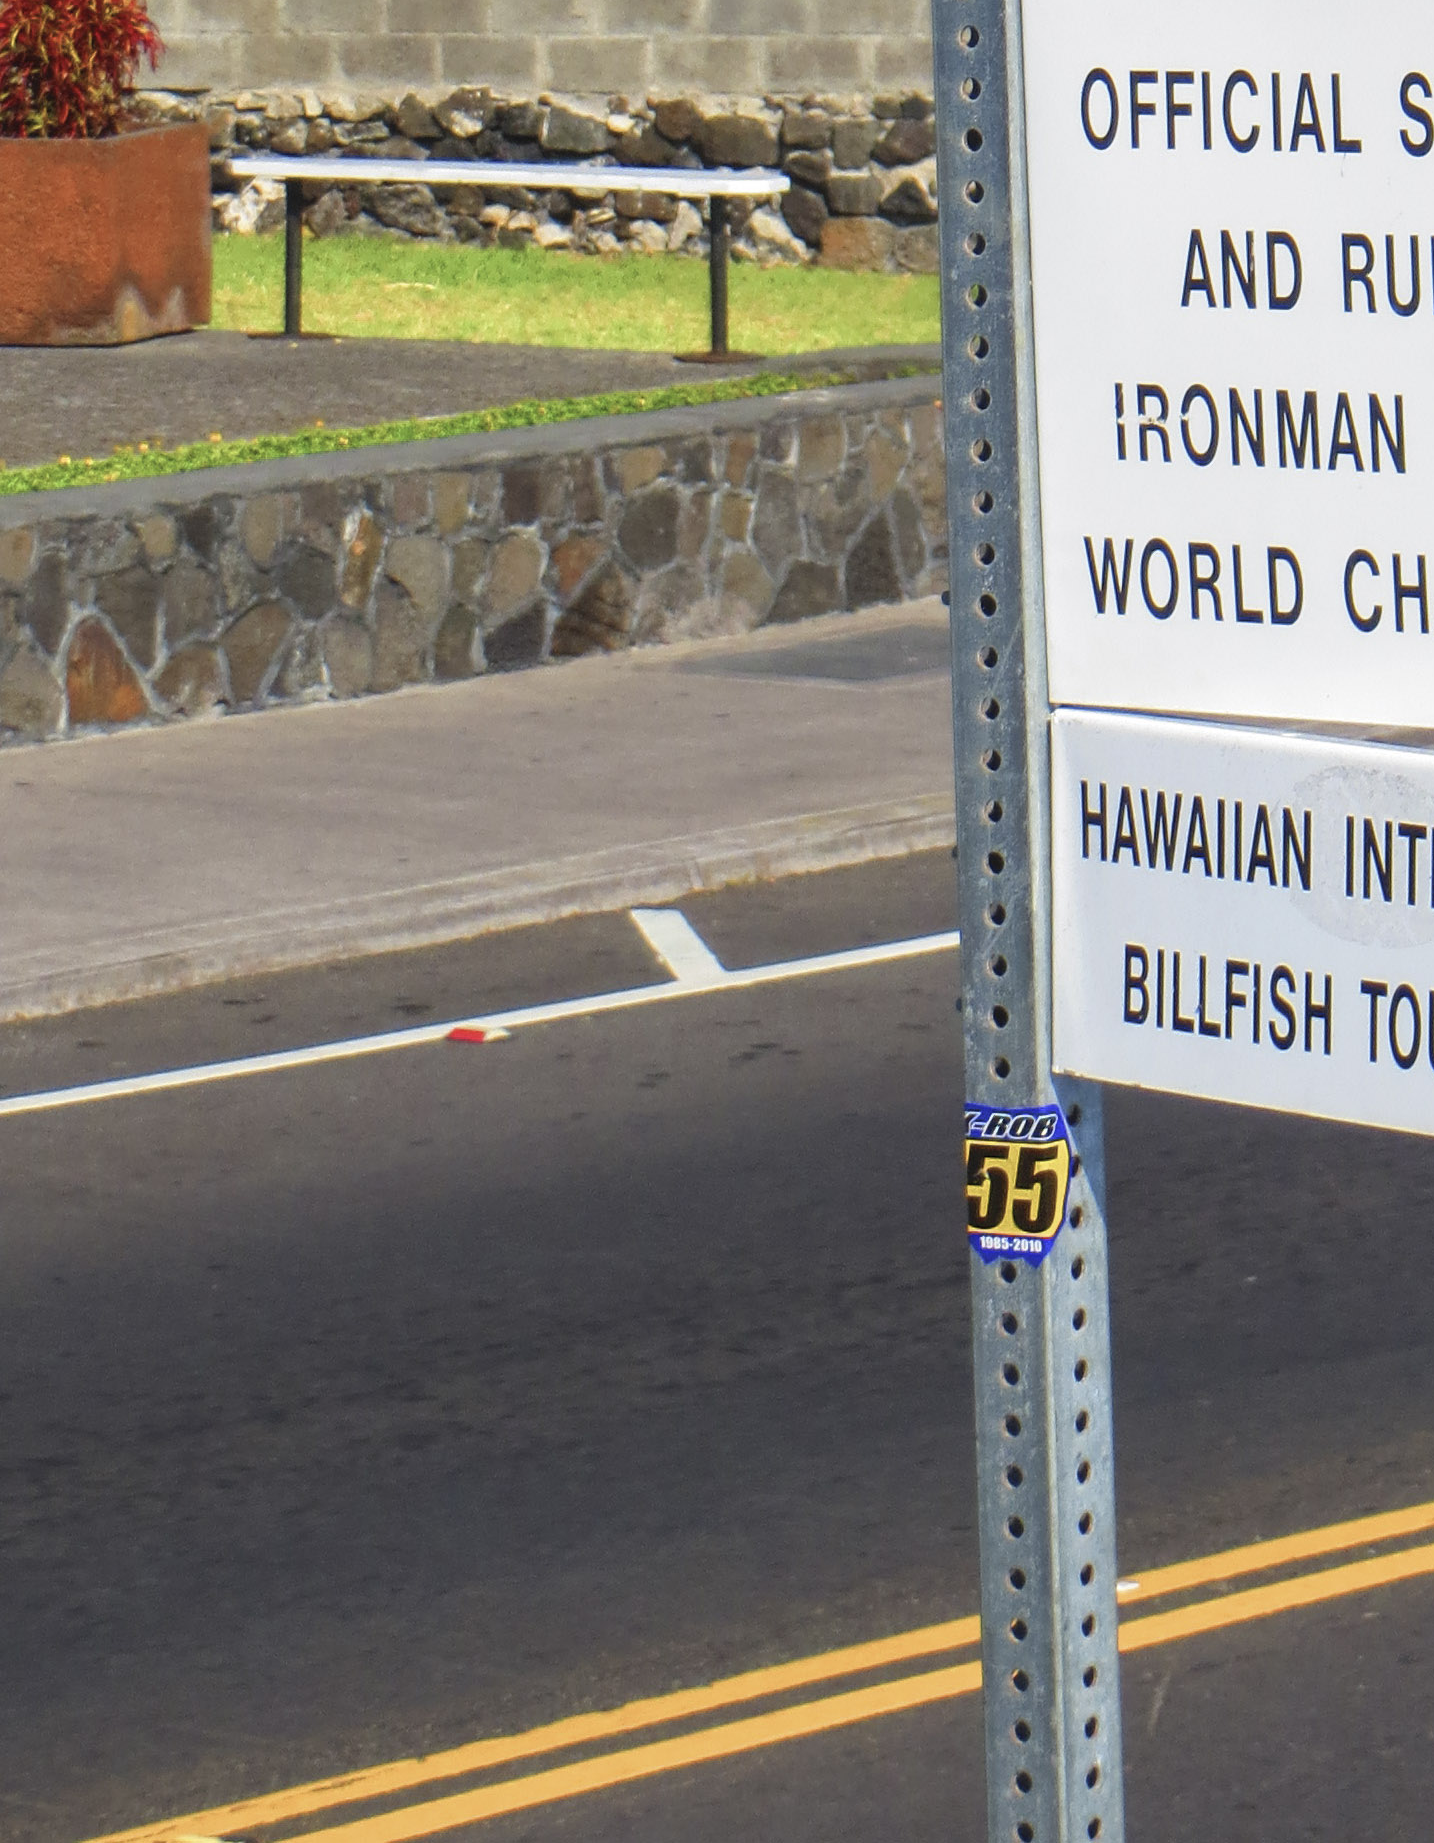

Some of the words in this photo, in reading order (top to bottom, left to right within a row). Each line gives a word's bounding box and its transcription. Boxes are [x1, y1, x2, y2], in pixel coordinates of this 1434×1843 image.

[1080, 68, 1362, 153] OFFICIAL
[1181, 229, 1302, 310] AND
[1114, 382, 1406, 474] IRONMAN
[1083, 536, 1303, 625] WORLD
[1080, 780, 1312, 891] HAWAIIAN
[1123, 944, 1332, 1055] BILLFISH
[967, 1143, 1059, 1234] 55
[979, 1235, 1042, 1253] 1985-2010
